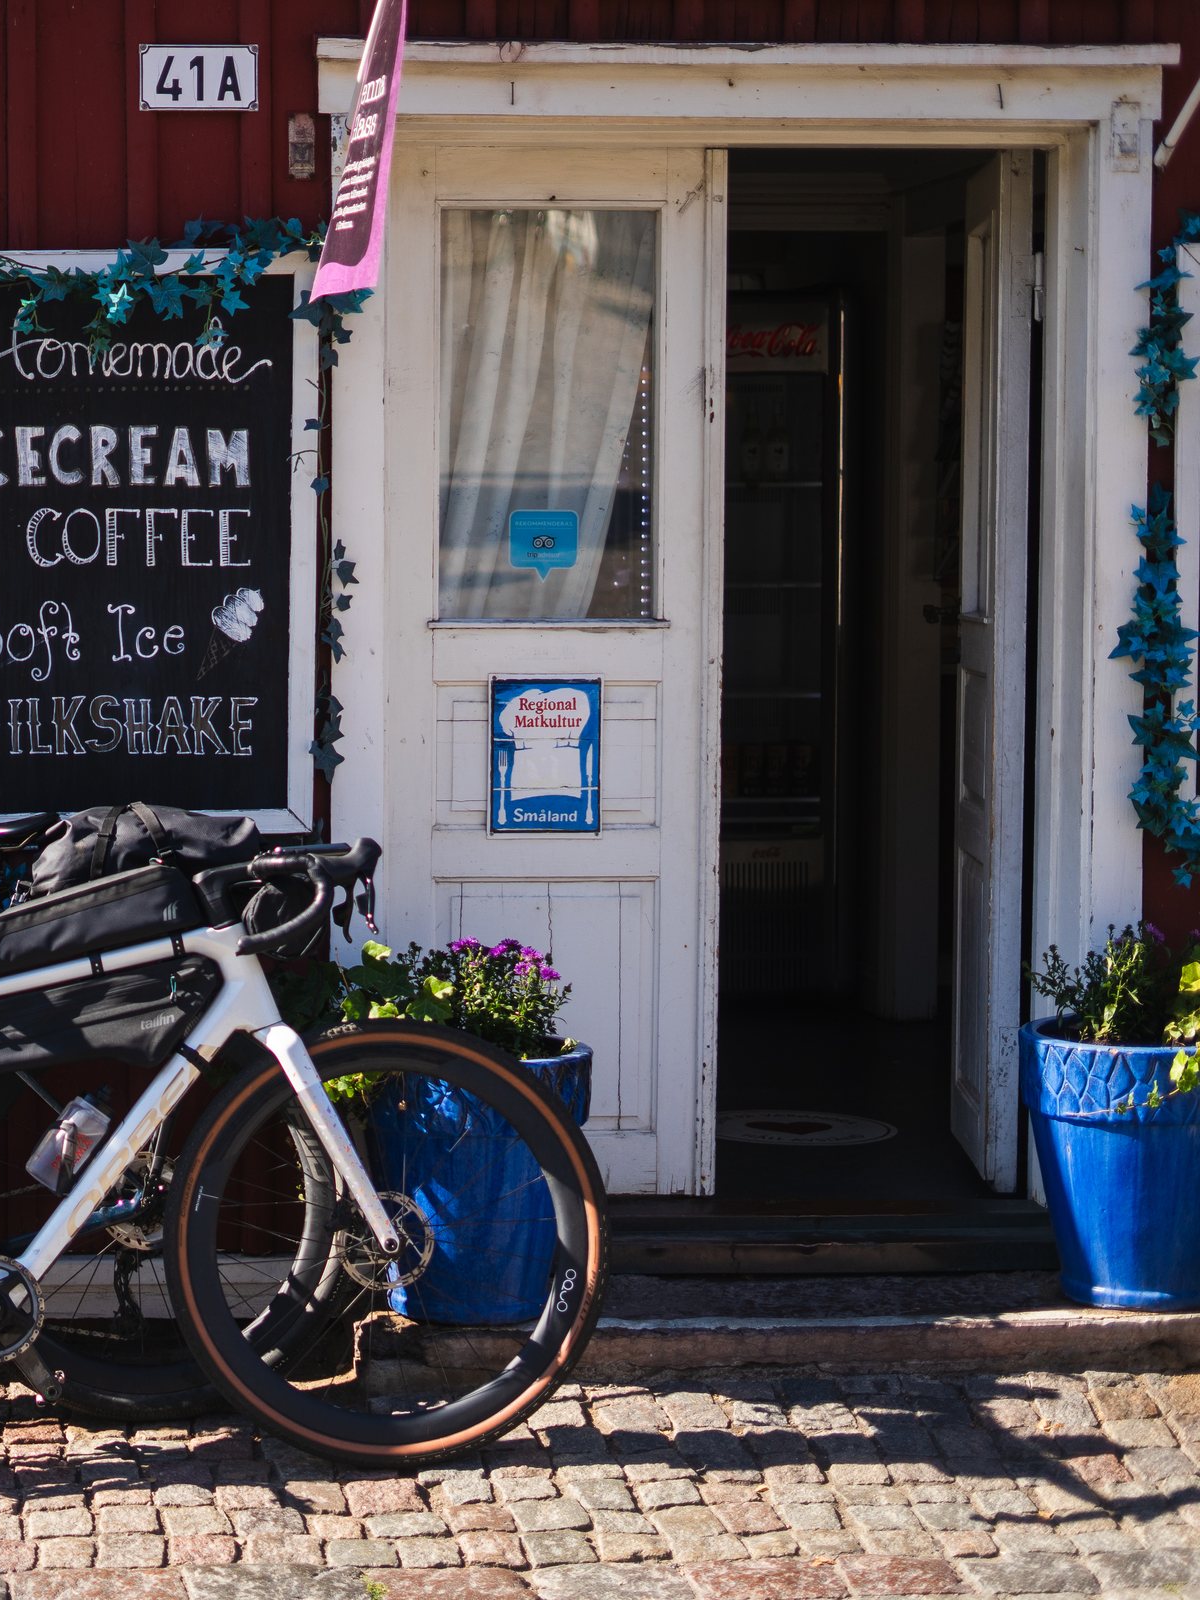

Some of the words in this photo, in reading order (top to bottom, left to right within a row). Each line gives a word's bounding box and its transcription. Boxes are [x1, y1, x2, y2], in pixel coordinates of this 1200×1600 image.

[26, 507, 252, 567] COFFEE
[107, 602, 186, 662] Ice
[518, 697, 577, 714] Regional
[514, 715, 582, 728] Matkultur
[513, 808, 578, 822] Småland
[140, 1012, 175, 1031] tailfin
